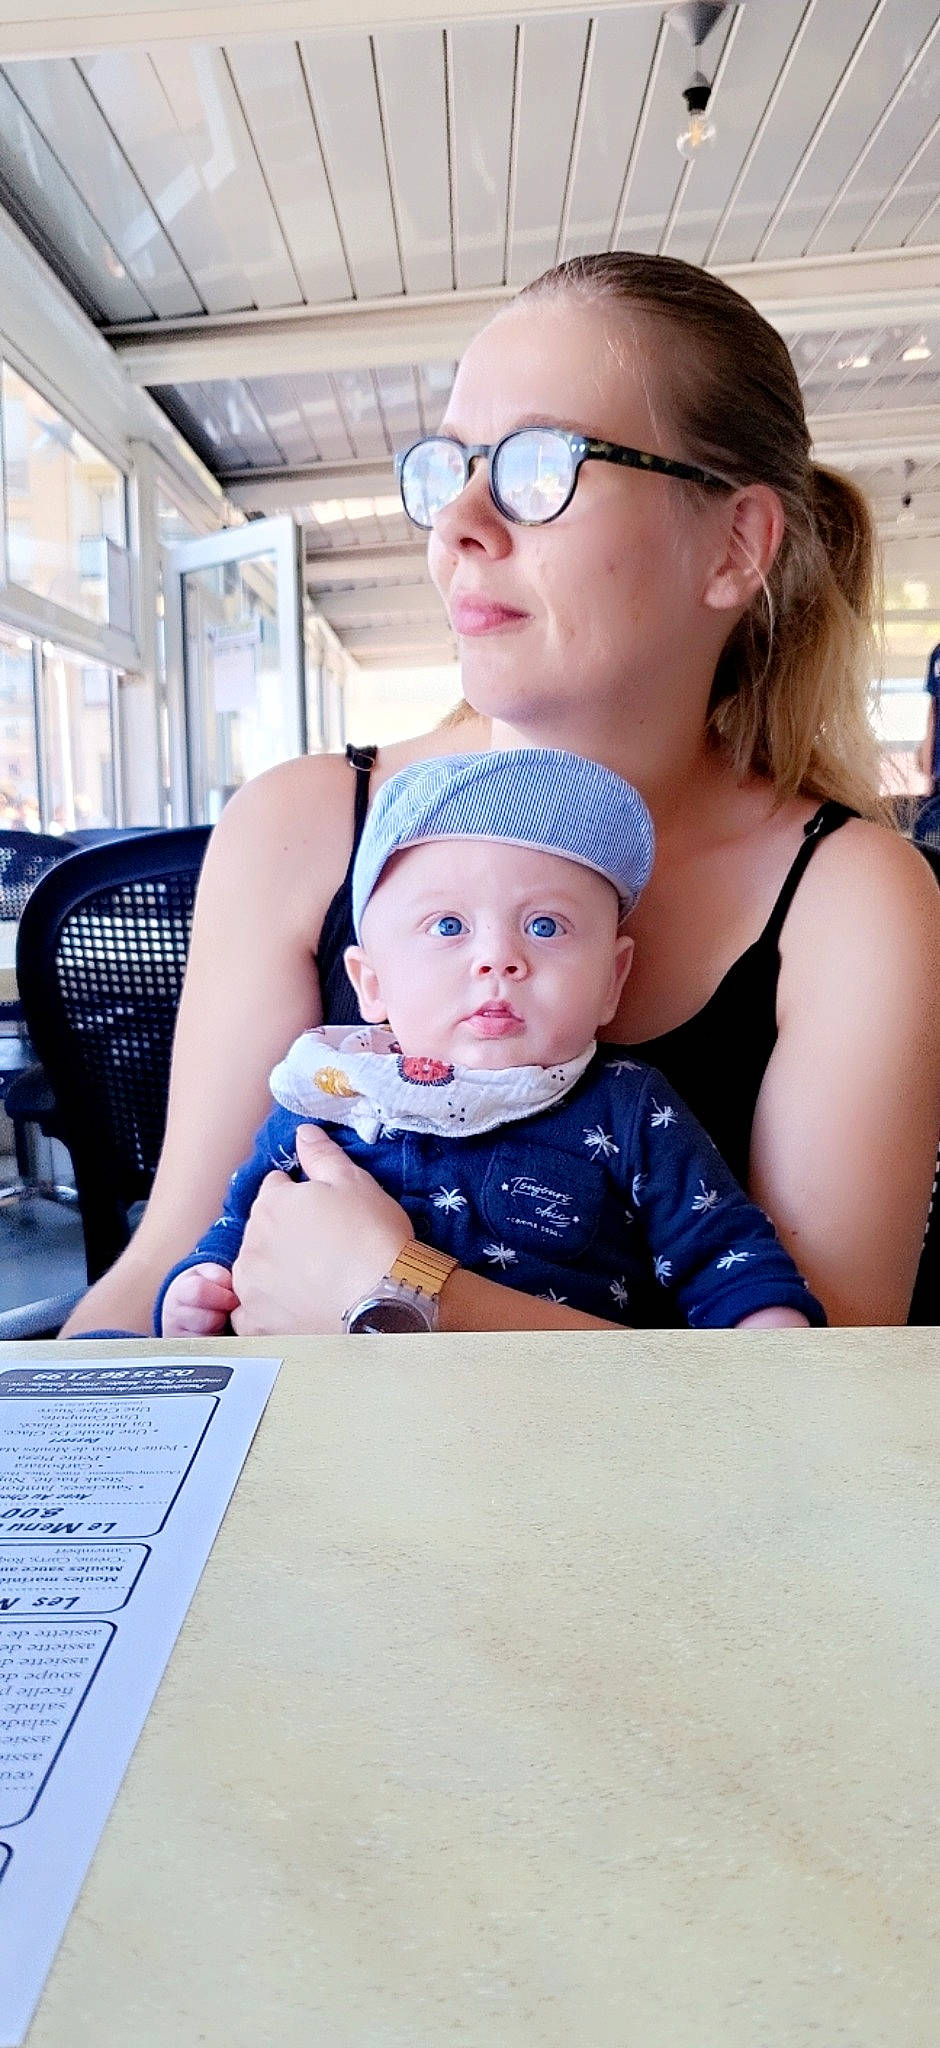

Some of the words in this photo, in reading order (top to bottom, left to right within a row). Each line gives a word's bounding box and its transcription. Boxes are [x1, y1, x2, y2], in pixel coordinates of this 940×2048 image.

[511, 1177, 573, 1202] Toujours
[163, 1369, 195, 1377] 02
[6, 1522, 84, 1534] Menu
[87, 1522, 118, 1534] Le
[32, 1597, 80, 1610] Les
[7, 1631, 30, 1640] de
[35, 1629, 103, 1638] assiette
[28, 1643, 96, 1652] assiette
[20, 1657, 90, 1667] assiette
[25, 1670, 82, 1680] soupe
[17, 1687, 75, 1698] ficelle
[4, 1703, 67, 1714] salade
[0, 1735, 52, 1745] assie
